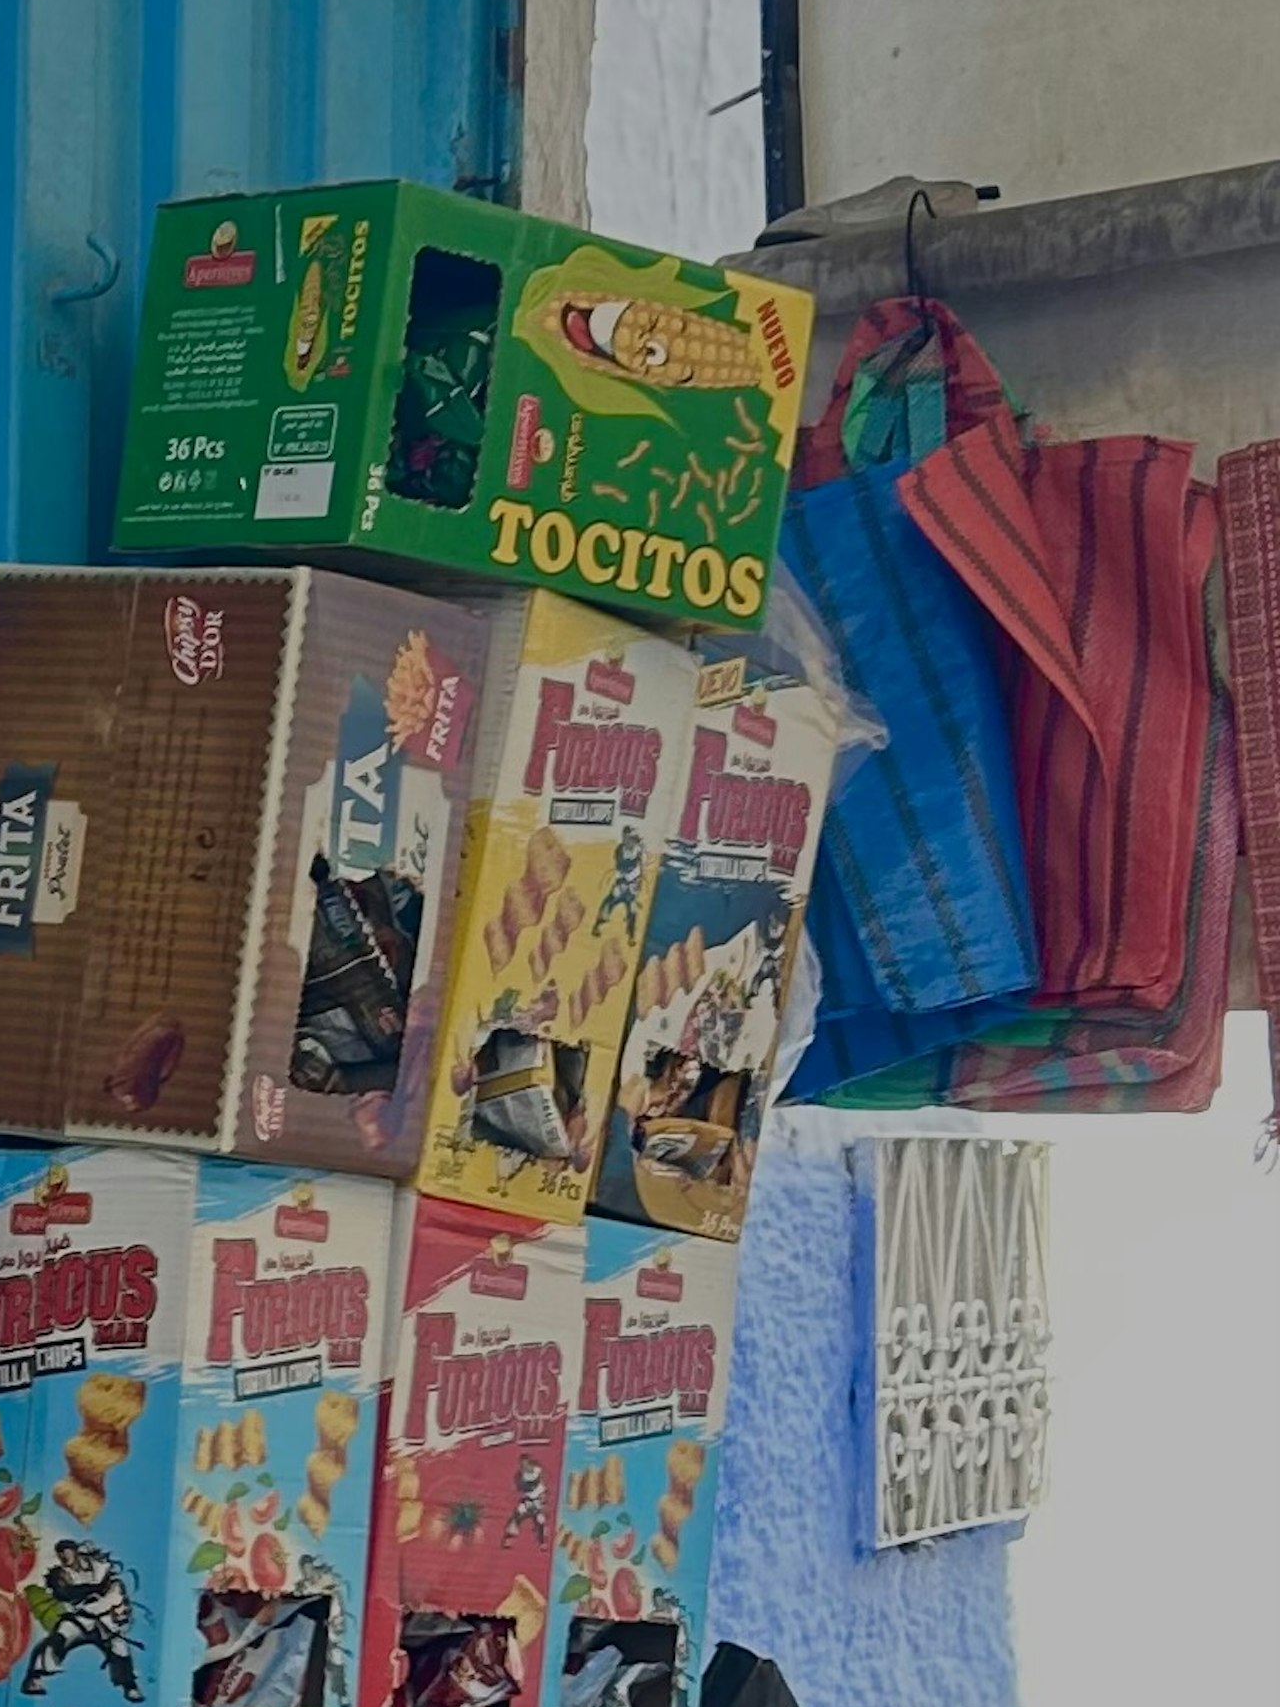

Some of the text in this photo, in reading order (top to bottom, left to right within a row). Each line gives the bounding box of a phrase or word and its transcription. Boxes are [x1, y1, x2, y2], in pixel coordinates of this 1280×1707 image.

[755, 297, 796, 390] NUEVO
[165, 435, 226, 462] 36 Pcs
[488, 496, 767, 617] TOCITOS
[168, 595, 199, 685] Chipsy
[199, 608, 225, 671] D'OR
[425, 675, 460, 762] FRITA
[205, 1237, 369, 1363] FURIOUS
[36, 1340, 84, 1371] CHIPS
[404, 1311, 561, 1441] FURIOUS
[578, 1297, 717, 1412] FURIOUS
